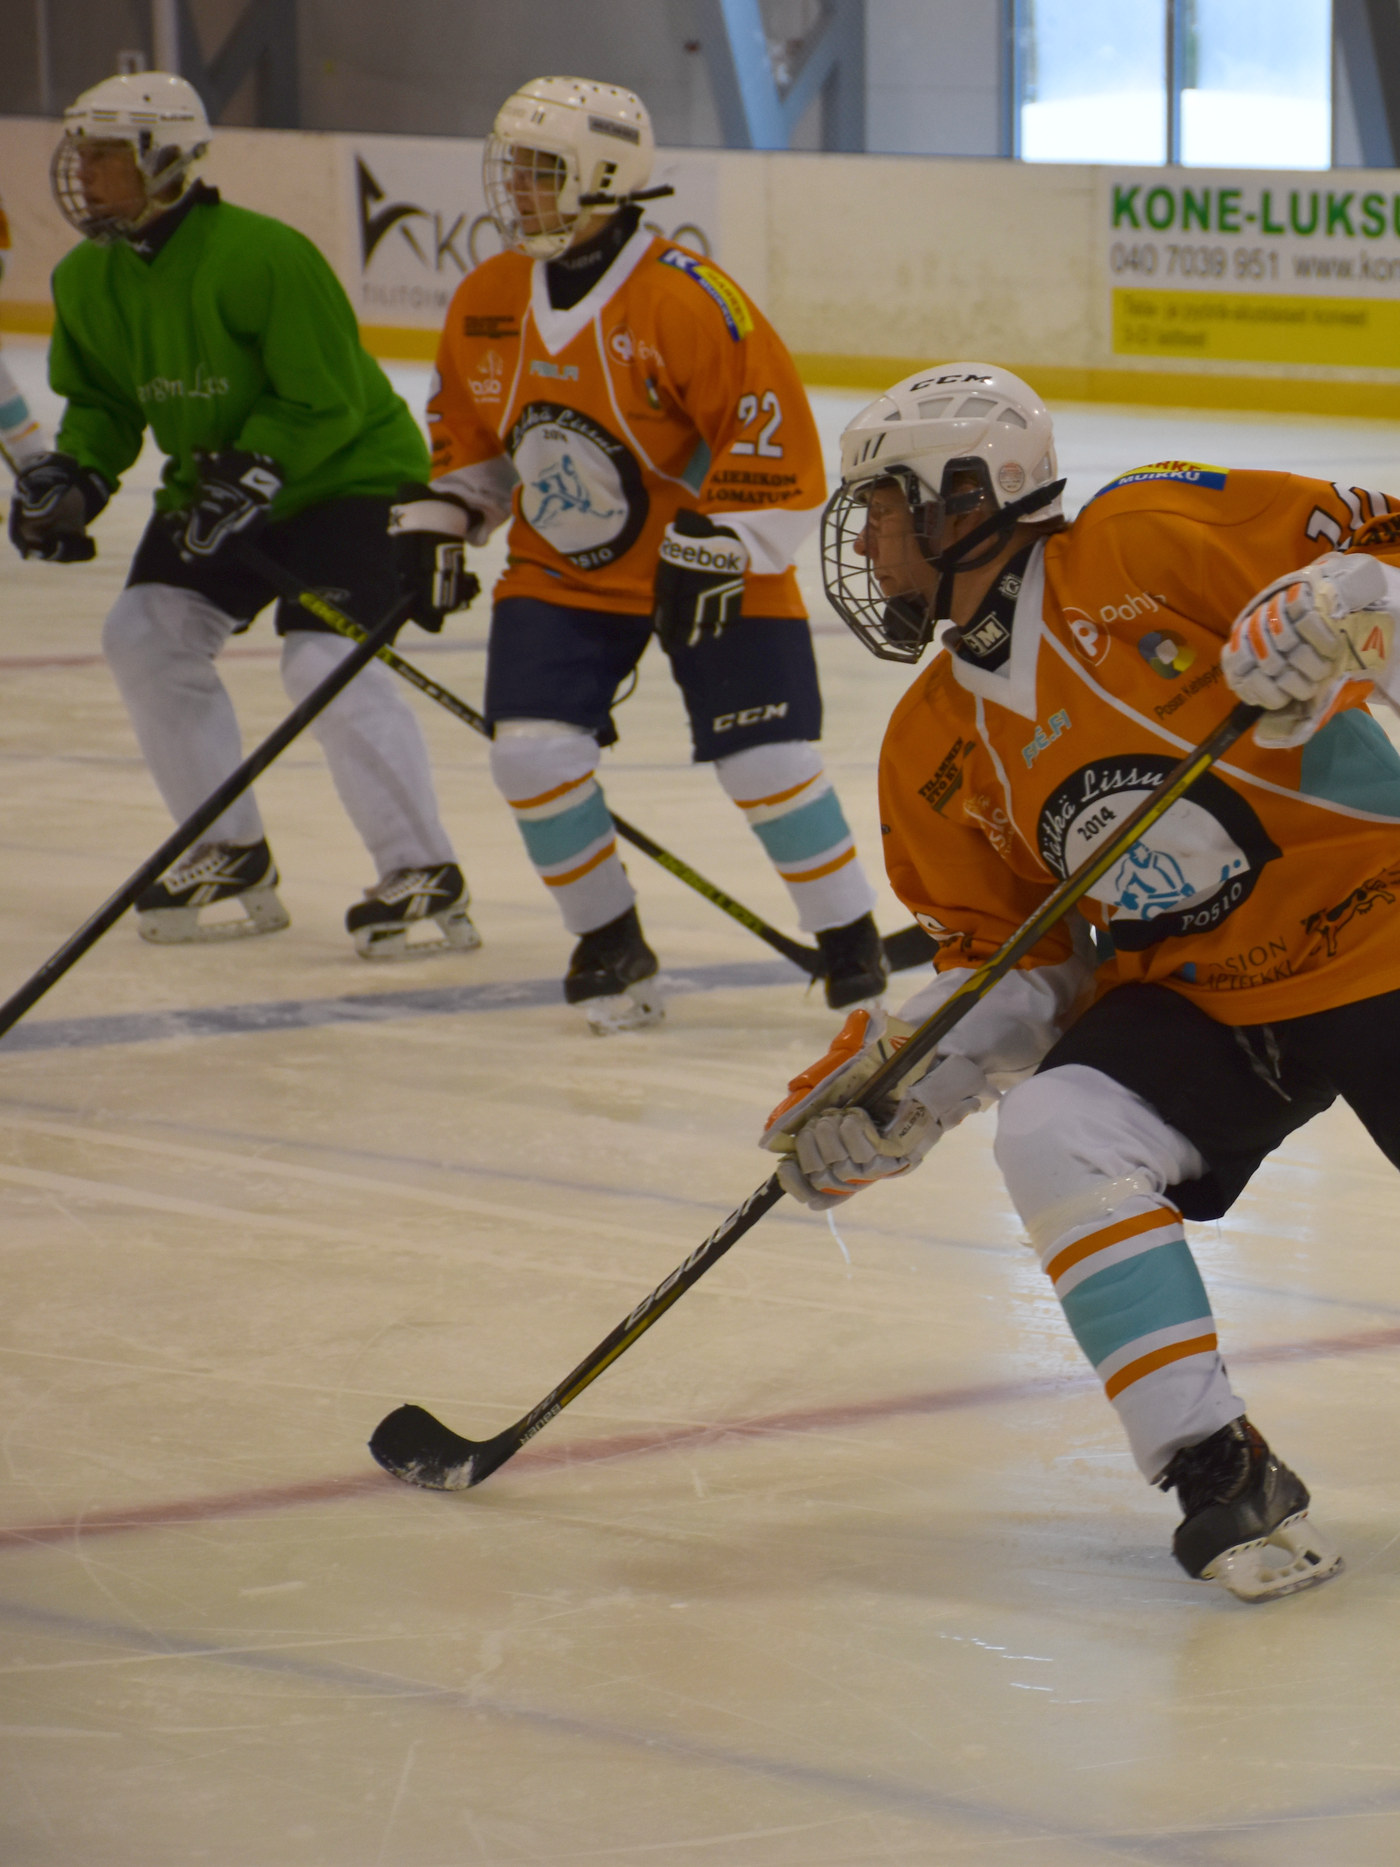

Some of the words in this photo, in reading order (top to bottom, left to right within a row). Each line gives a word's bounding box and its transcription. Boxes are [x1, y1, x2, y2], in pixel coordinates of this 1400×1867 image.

[1111, 242, 1157, 276] 040
[1165, 244, 1228, 279] 7039
[1233, 246, 1279, 281] 951
[909, 374, 994, 392] CCM
[730, 391, 784, 459] 22
[712, 702, 789, 734] CCM
[1081, 767, 1166, 803] Lissu
[1077, 805, 1117, 842] 2014
[1180, 881, 1243, 931] POSIO
